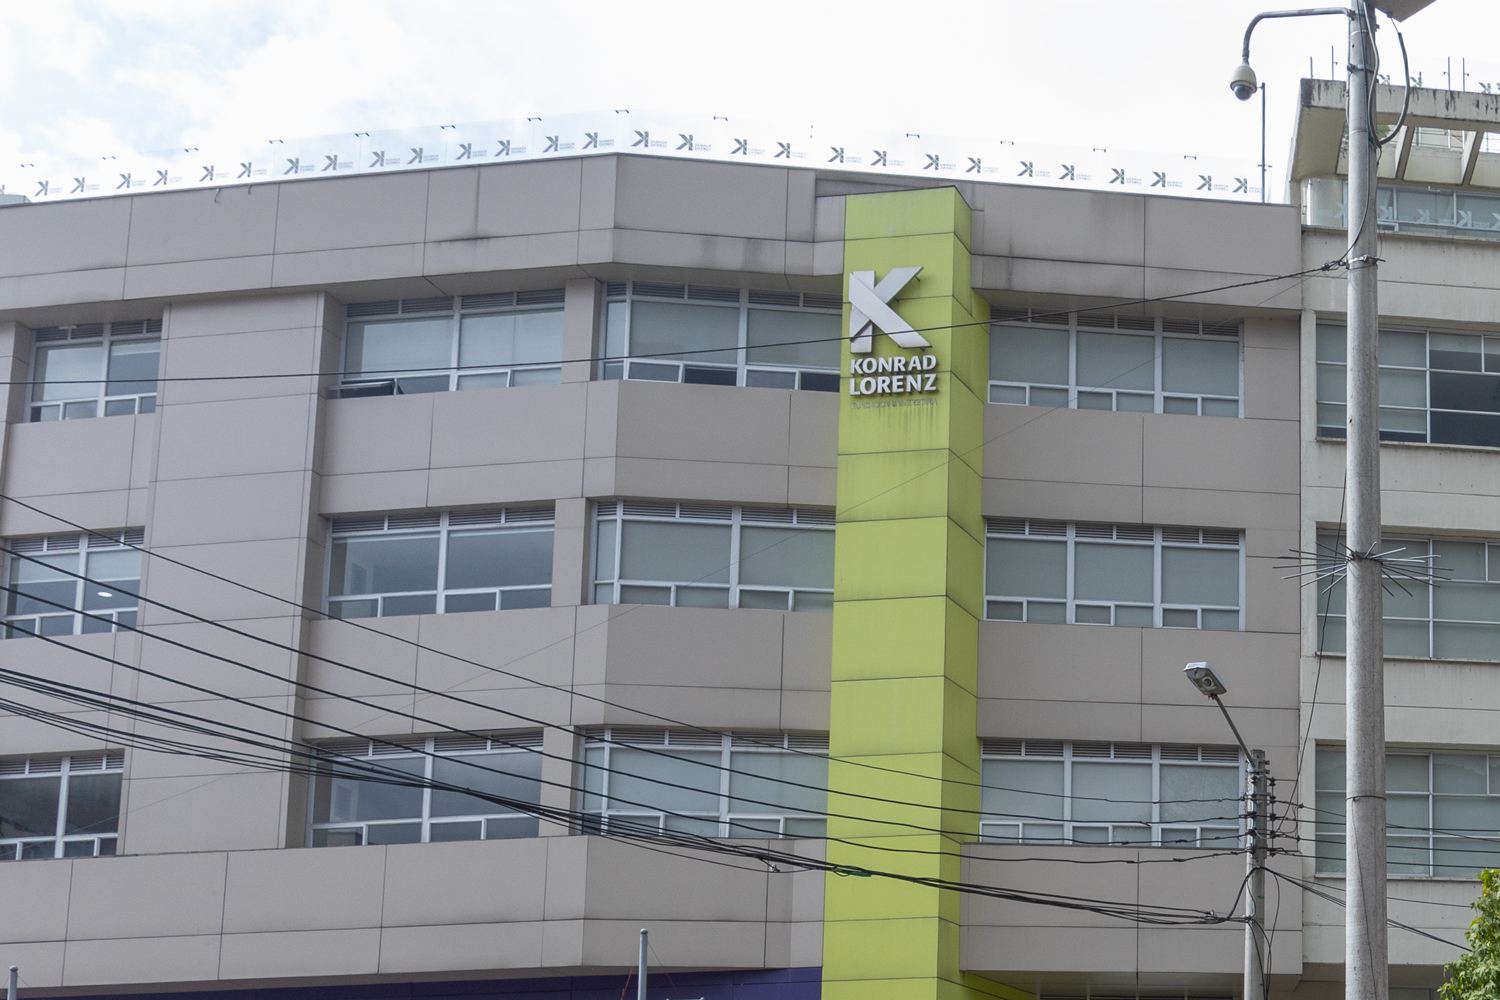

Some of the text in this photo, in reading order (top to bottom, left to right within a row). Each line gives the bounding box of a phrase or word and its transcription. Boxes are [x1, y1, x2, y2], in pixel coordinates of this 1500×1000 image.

[849, 266, 932, 354] K
[850, 354, 937, 375] KONRAD
[850, 373, 937, 396] LORENZ
